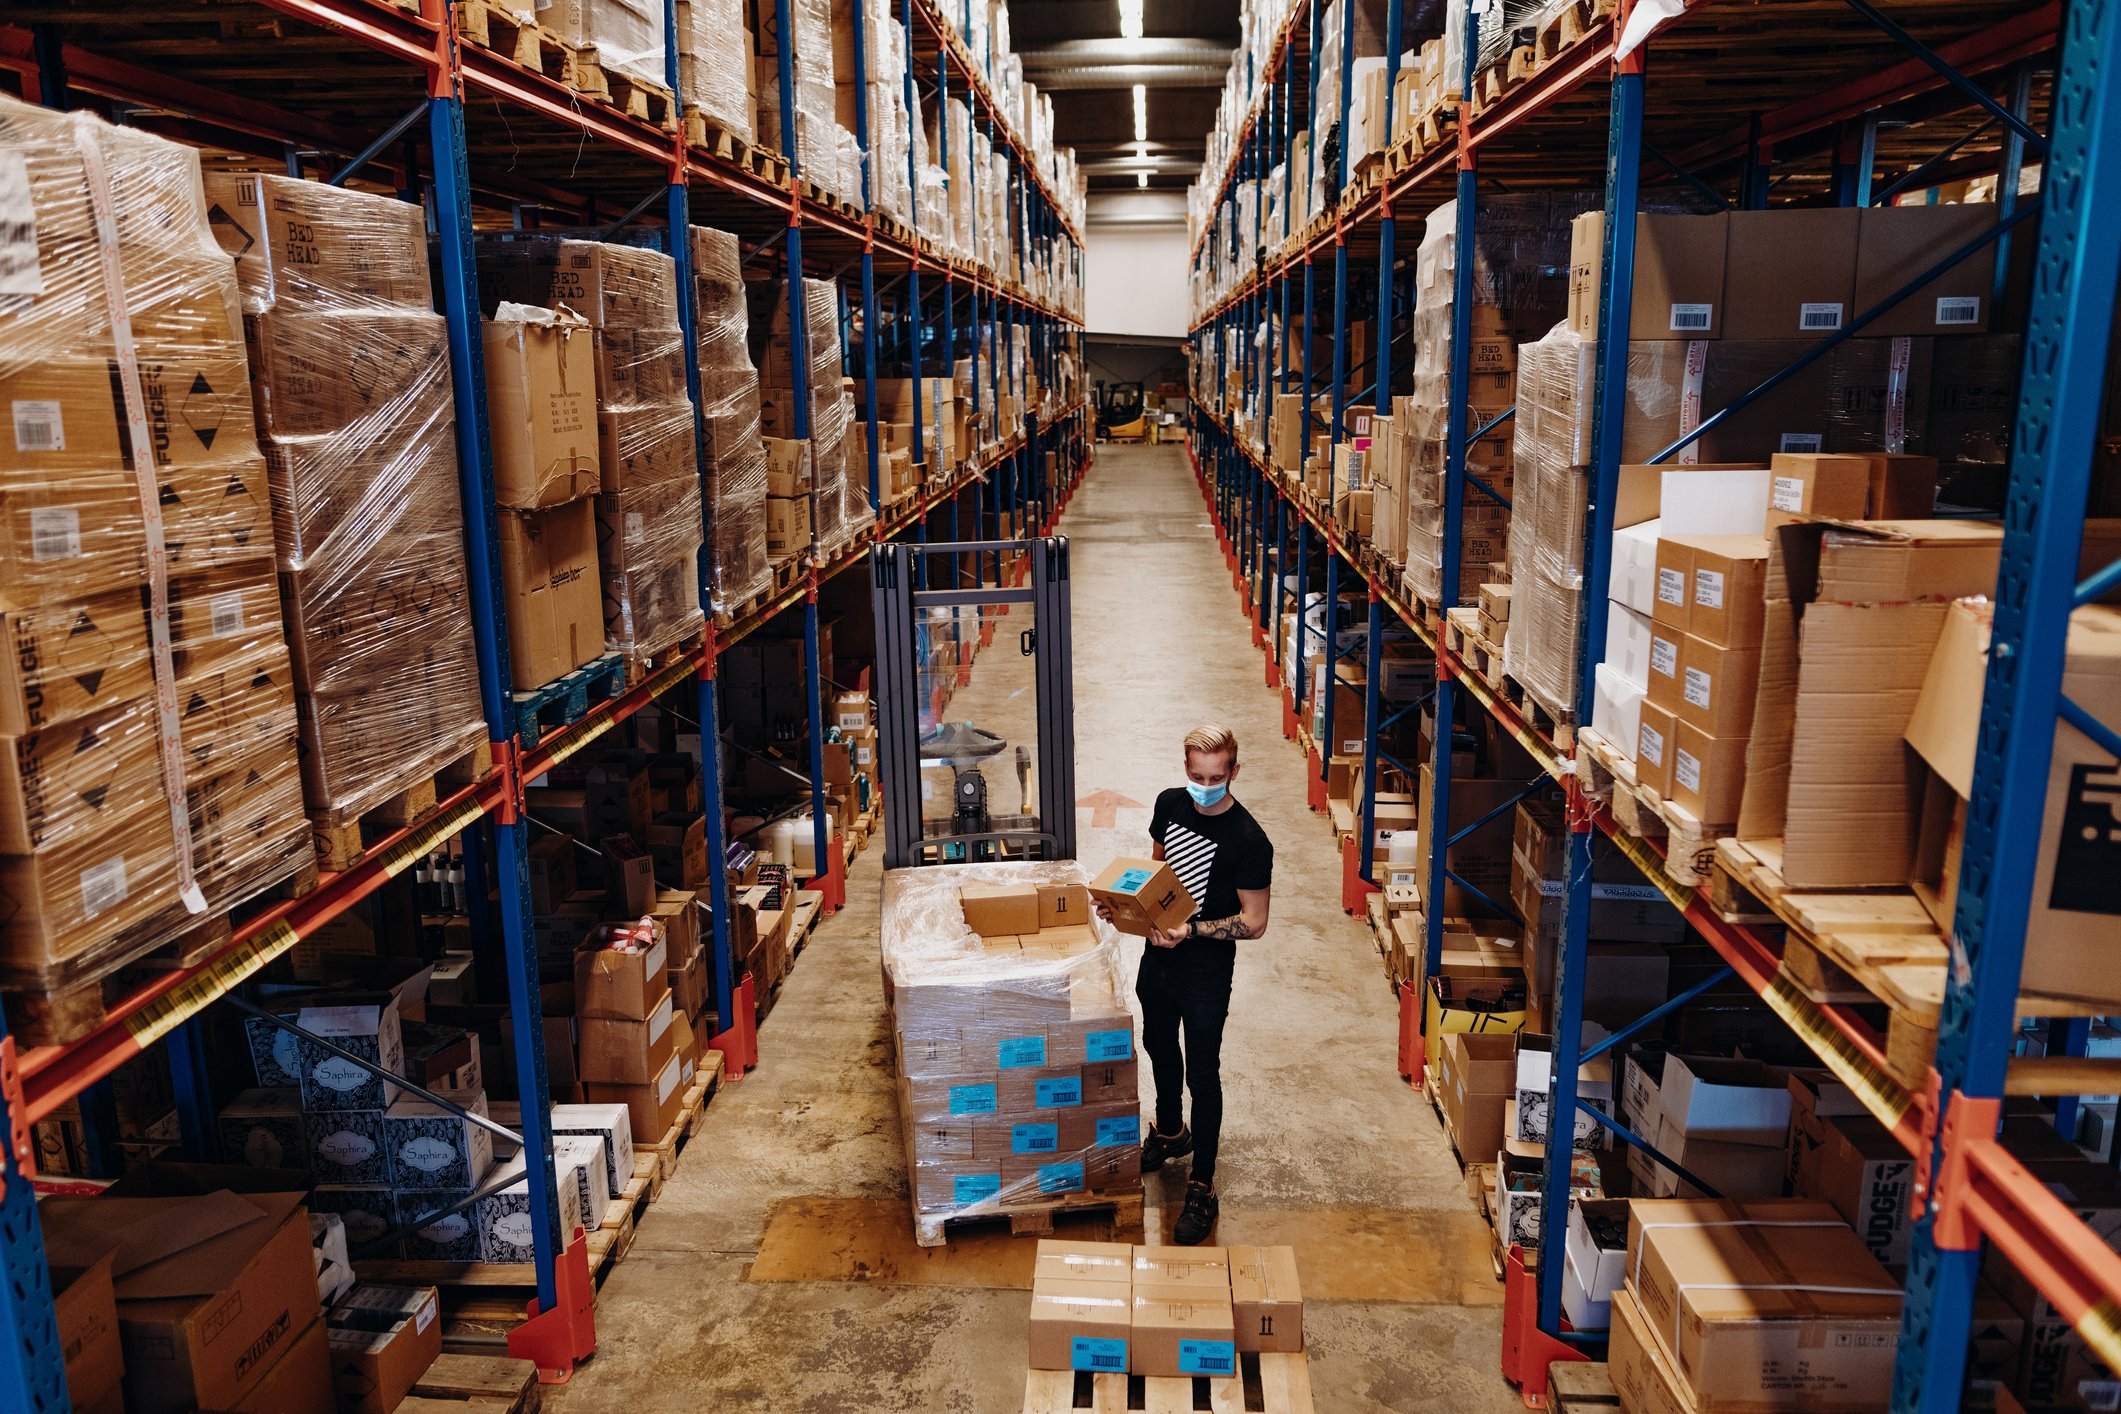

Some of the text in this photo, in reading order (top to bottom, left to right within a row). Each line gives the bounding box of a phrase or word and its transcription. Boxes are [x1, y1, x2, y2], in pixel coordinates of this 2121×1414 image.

[287, 221, 314, 243] BED
[286, 243, 320, 264] HEAD
[551, 272, 579, 284] BED
[547, 285, 585, 298] HEAD
[1478, 354, 1502, 362] HEAD
[1481, 345, 1500, 354] BED
[1688, 341, 1697, 367] CAUTIO
[289, 355, 316, 373] BED
[288, 376, 322, 396] HEAD
[148, 384, 172, 466] FUDGE
[1469, 548, 1492, 556] HEAD
[1472, 540, 1490, 548] BED
[18, 634, 47, 727] FUDGE
[319, 1068, 364, 1084] Saphira
[326, 1141, 368, 1159] Saphira
[406, 1148, 448, 1164] Saphira
[500, 1222, 531, 1238] Saphi
[1866, 1181, 1899, 1262] FUDGE
